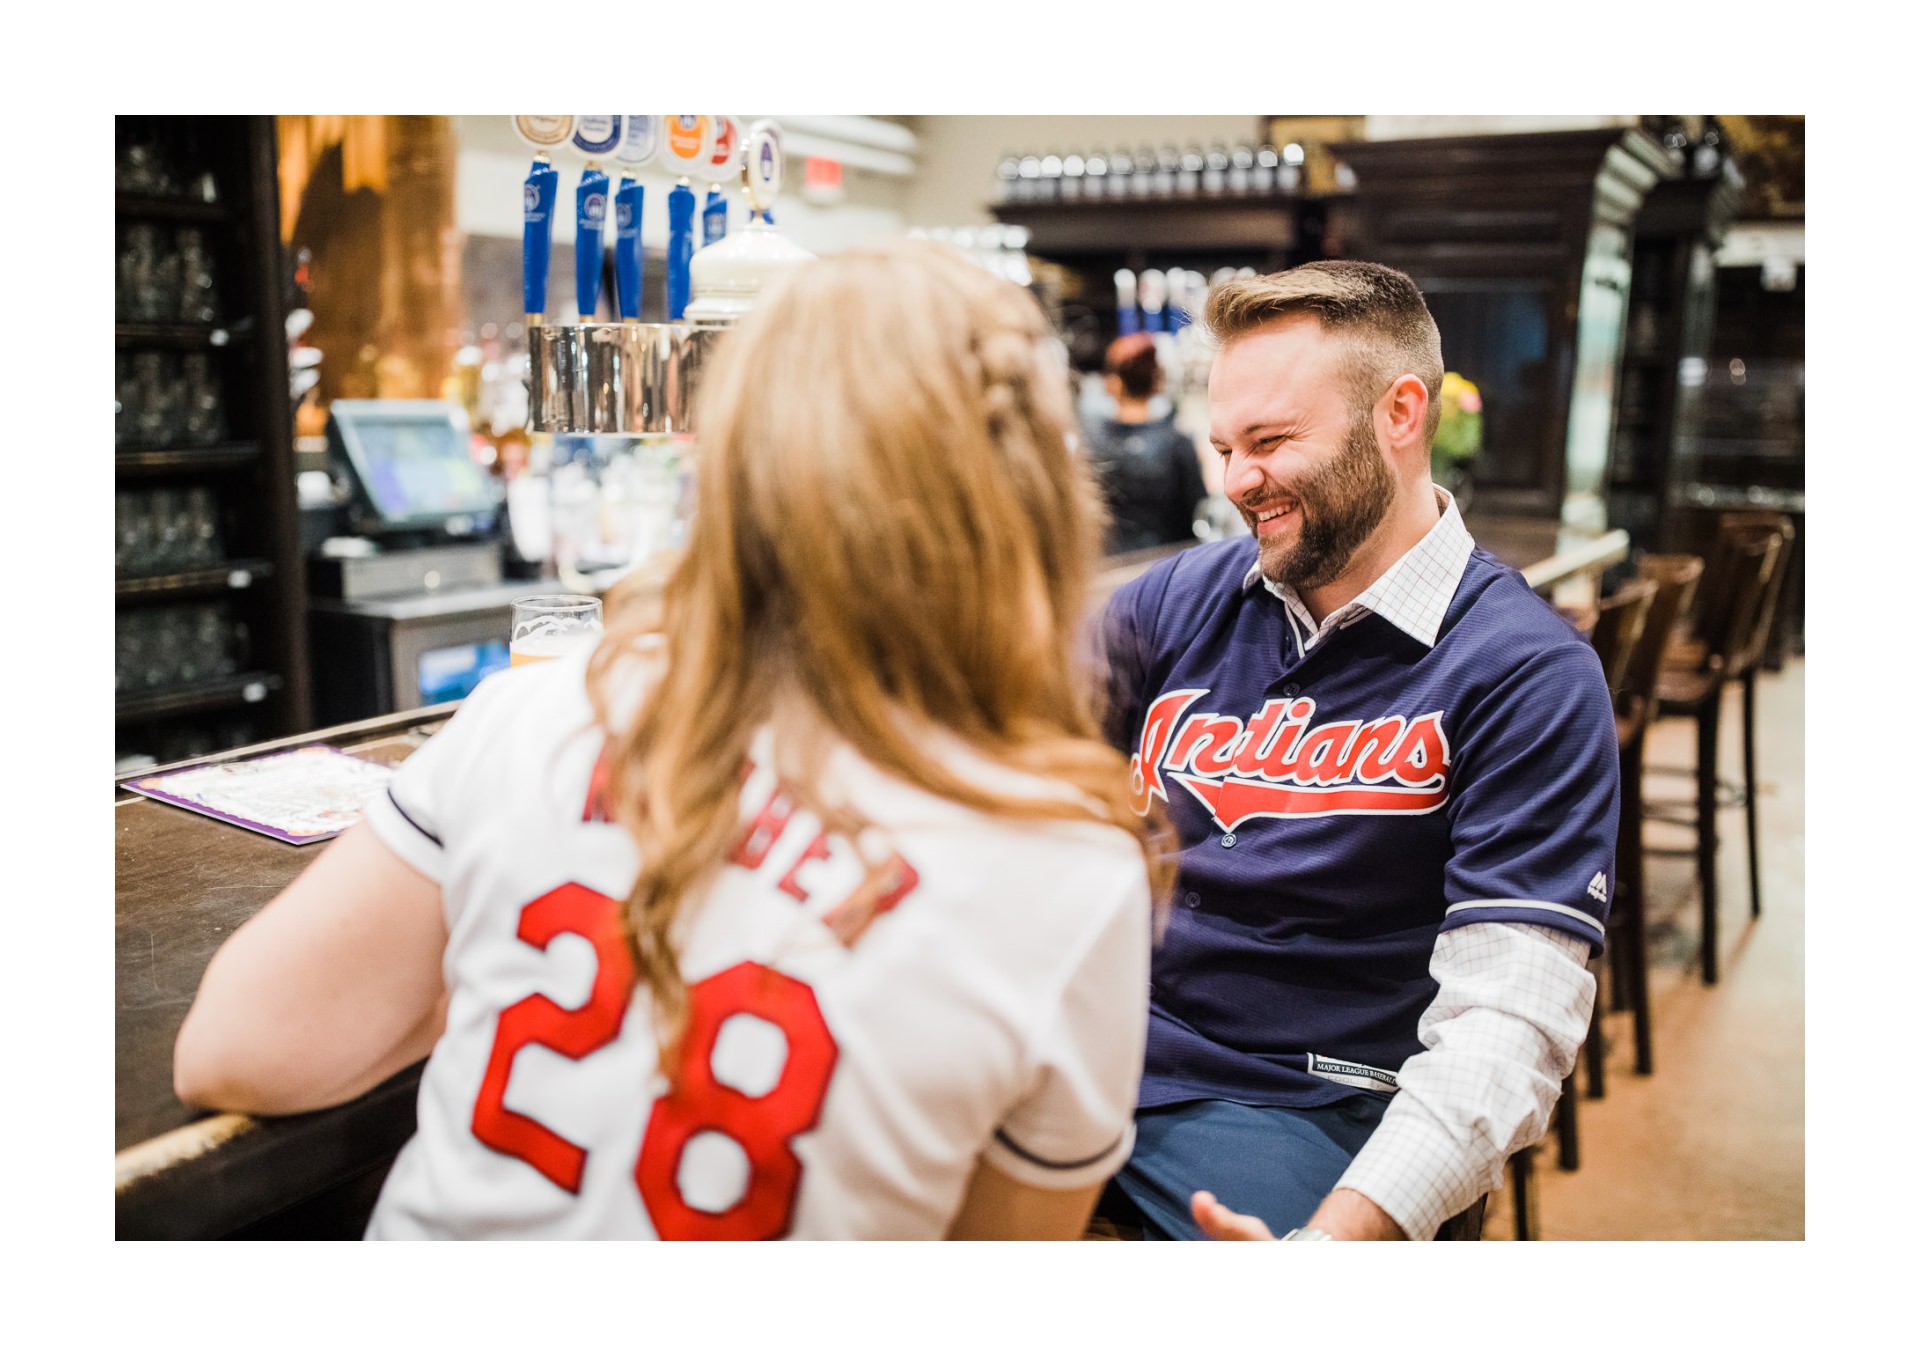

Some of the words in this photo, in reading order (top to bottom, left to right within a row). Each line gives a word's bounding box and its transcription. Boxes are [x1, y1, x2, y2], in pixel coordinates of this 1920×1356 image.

[1131, 689, 1451, 818] Indians
[472, 882, 838, 1241] 28
[1317, 1064, 1341, 1073] MAJOR
[1342, 1067, 1369, 1076] LEAGUE
